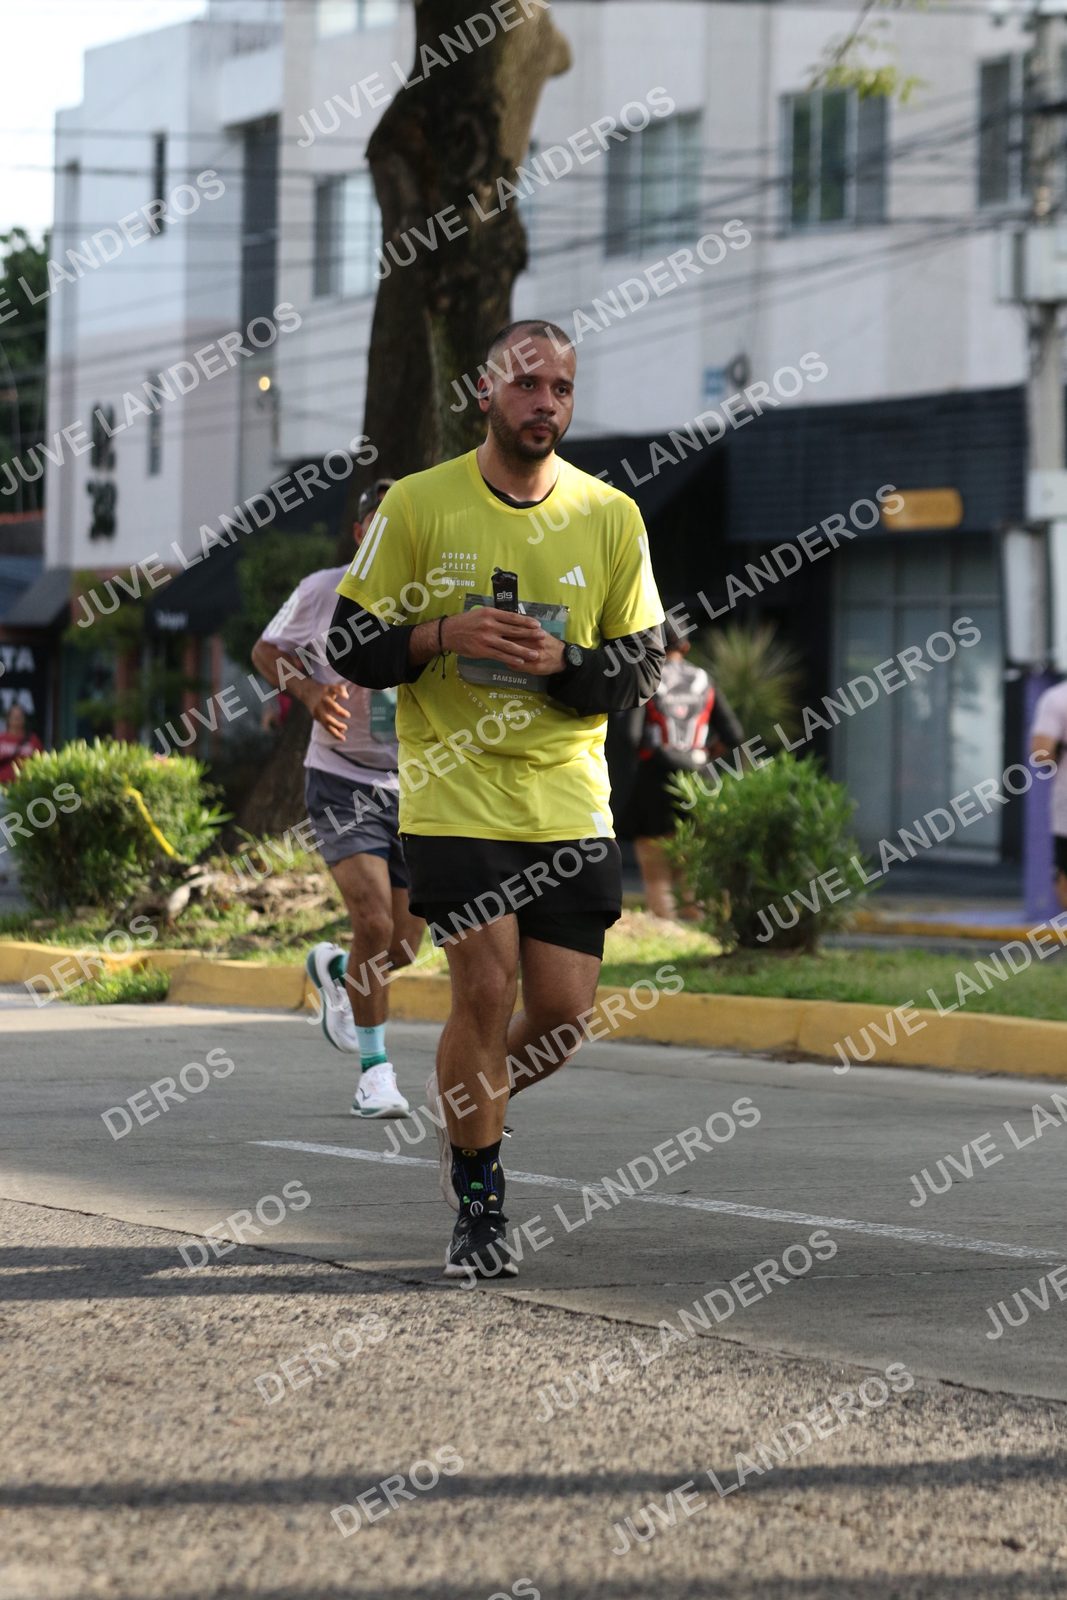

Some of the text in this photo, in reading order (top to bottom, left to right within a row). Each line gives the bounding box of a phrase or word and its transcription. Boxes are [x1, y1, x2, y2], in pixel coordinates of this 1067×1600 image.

[441, 552, 478, 560] ADIDAS
[442, 562, 476, 570] SPLITS
[441, 578, 475, 587] SAMSUNG
[492, 674, 528, 685] SAMSUNG
